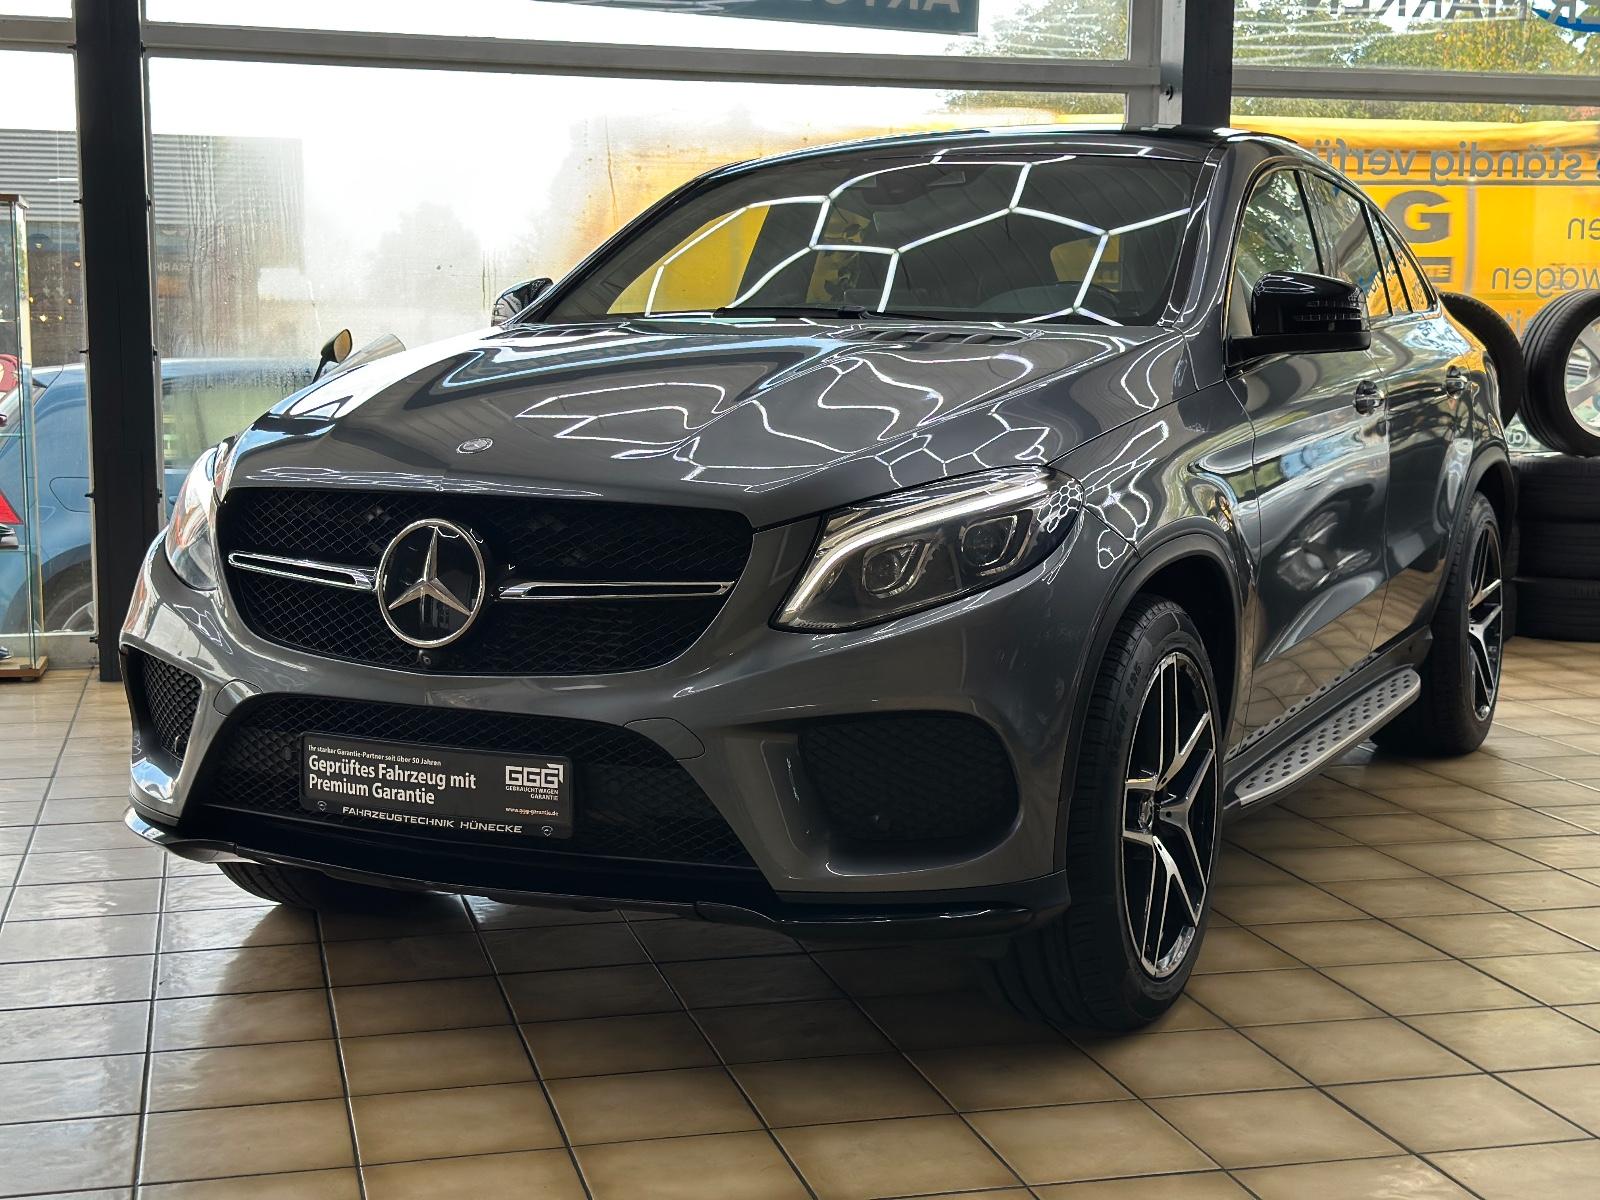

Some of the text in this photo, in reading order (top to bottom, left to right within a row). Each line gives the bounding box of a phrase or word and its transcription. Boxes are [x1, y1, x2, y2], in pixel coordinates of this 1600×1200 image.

[308, 754, 476, 790] Geprüftes Fahrzeug mit
[309, 773, 435, 805] Premium Garantie
[505, 785, 559, 795] GEBRAUCHTWAGEN
[530, 793, 559, 801] GARANTIE
[342, 806, 523, 834] FAHRZEUGTECHNIK HÜNECKE
